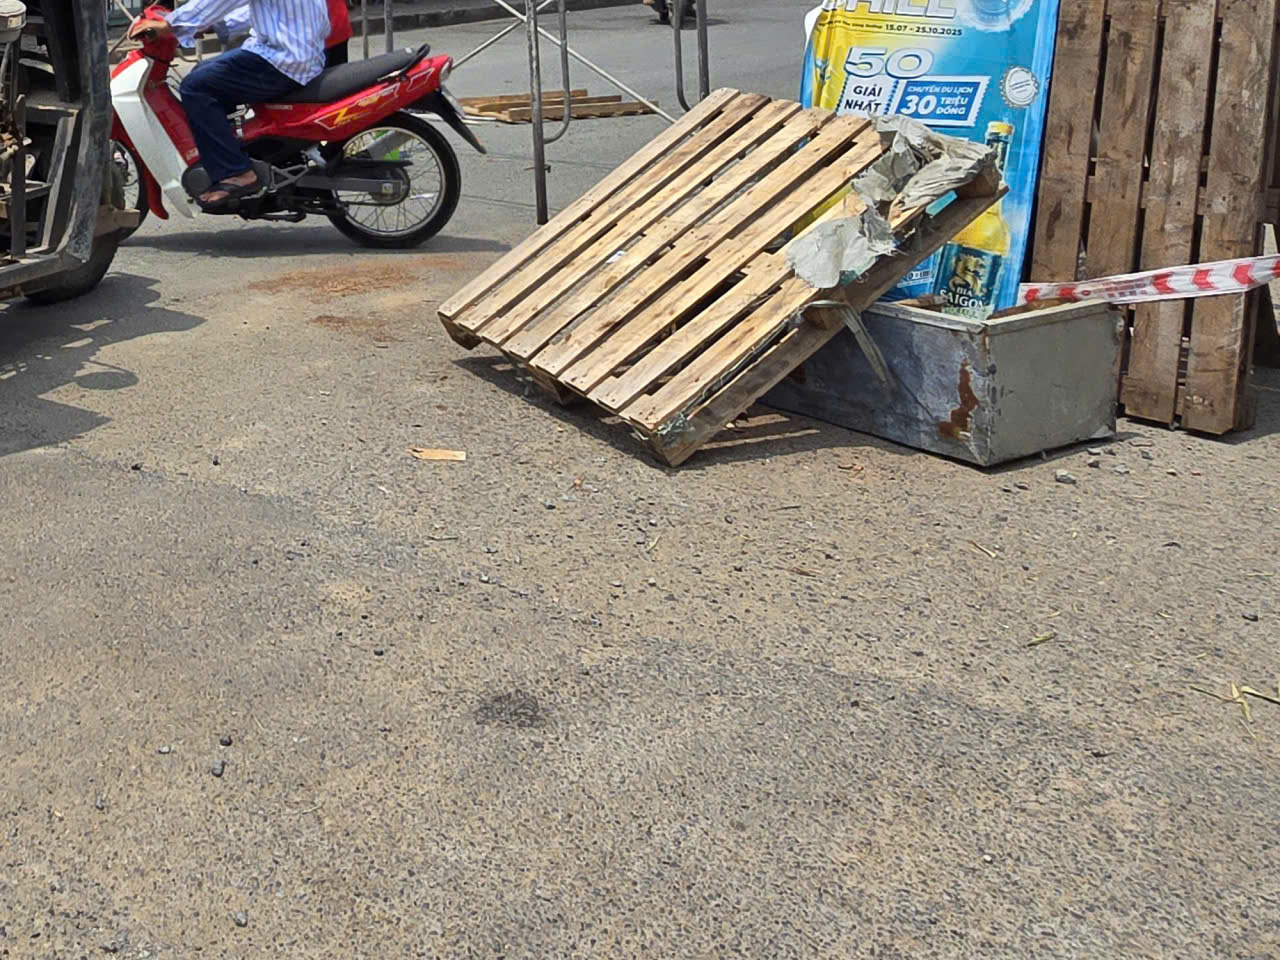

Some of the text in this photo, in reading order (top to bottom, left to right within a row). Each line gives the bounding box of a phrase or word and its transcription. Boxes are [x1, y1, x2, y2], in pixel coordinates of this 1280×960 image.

[885, 24, 908, 32] 15.07
[915, 26, 963, 36] 25.10.2025
[844, 47, 934, 79] 50
[853, 83, 883, 97] GIẢI
[844, 99, 882, 113] NHẤT
[900, 95, 937, 115] 30
